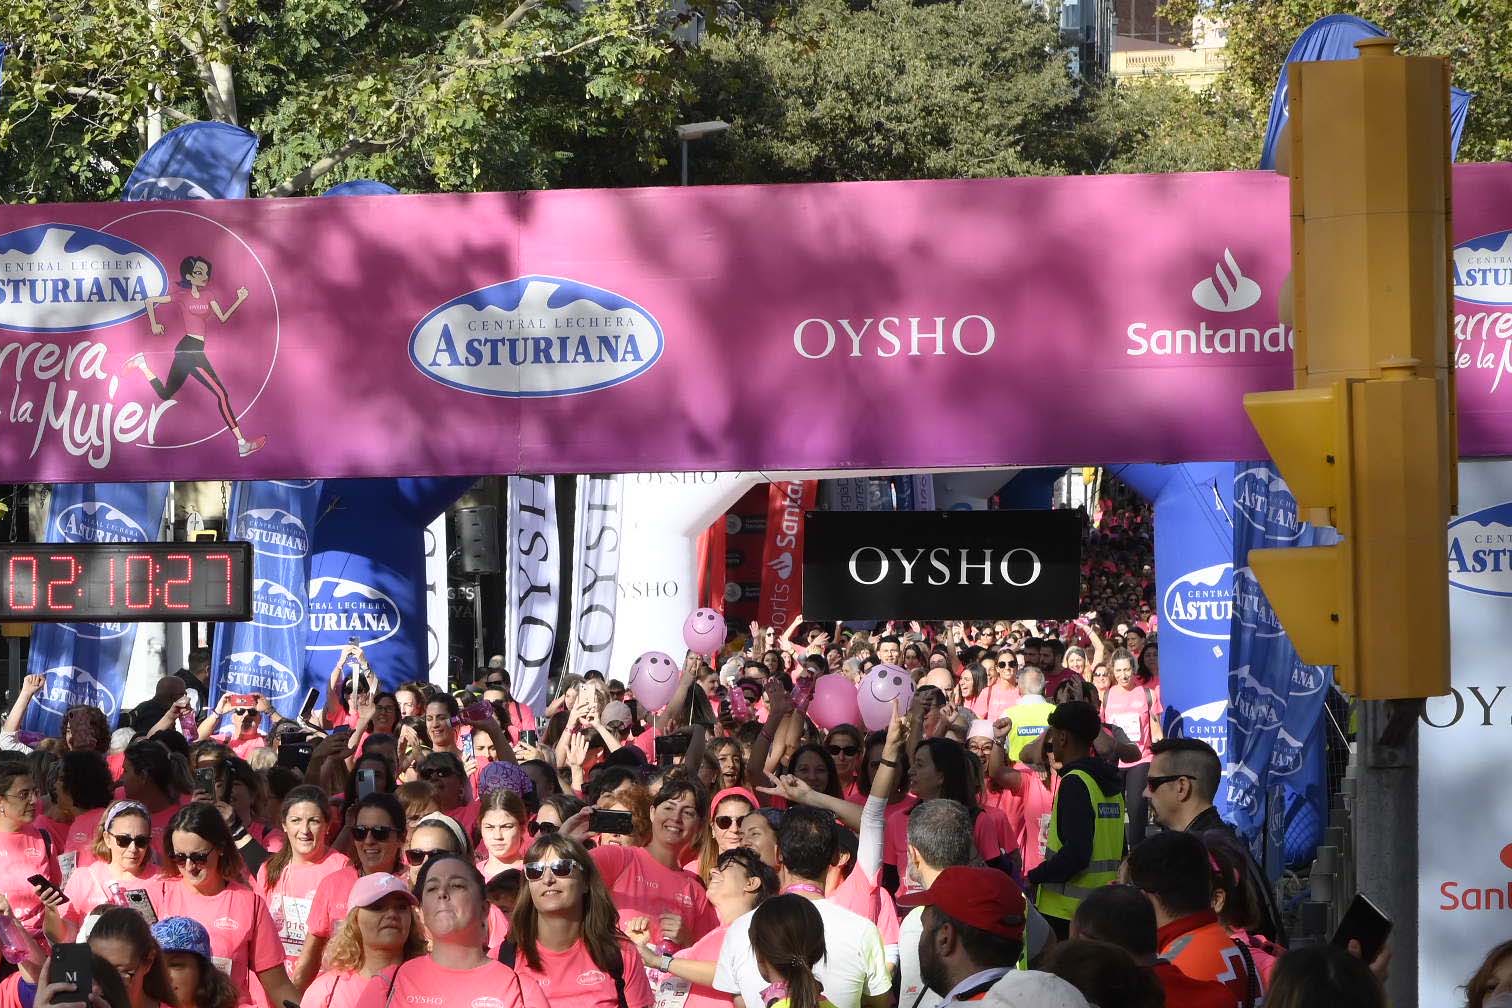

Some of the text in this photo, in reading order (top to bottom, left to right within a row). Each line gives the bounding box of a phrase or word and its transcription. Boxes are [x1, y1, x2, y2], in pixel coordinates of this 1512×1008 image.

[71, 259, 144, 272] LECHERA
[467, 315, 635, 331] CENTRAL LECHERA
[793, 314, 995, 360] OYSHO
[428, 323, 643, 368] ASTURIANA
[1476, 342, 1494, 369] la
[10, 384, 34, 424] la
[29, 374, 177, 469] Mujer
[8, 553, 232, 610] 02:10:27
[848, 546, 1042, 588] OYSHO
[337, 601, 387, 610] LECHERA
[1419, 686, 1512, 728] OY
[286, 921, 305, 931] 016
[406, 995, 443, 1005] OYSHO
